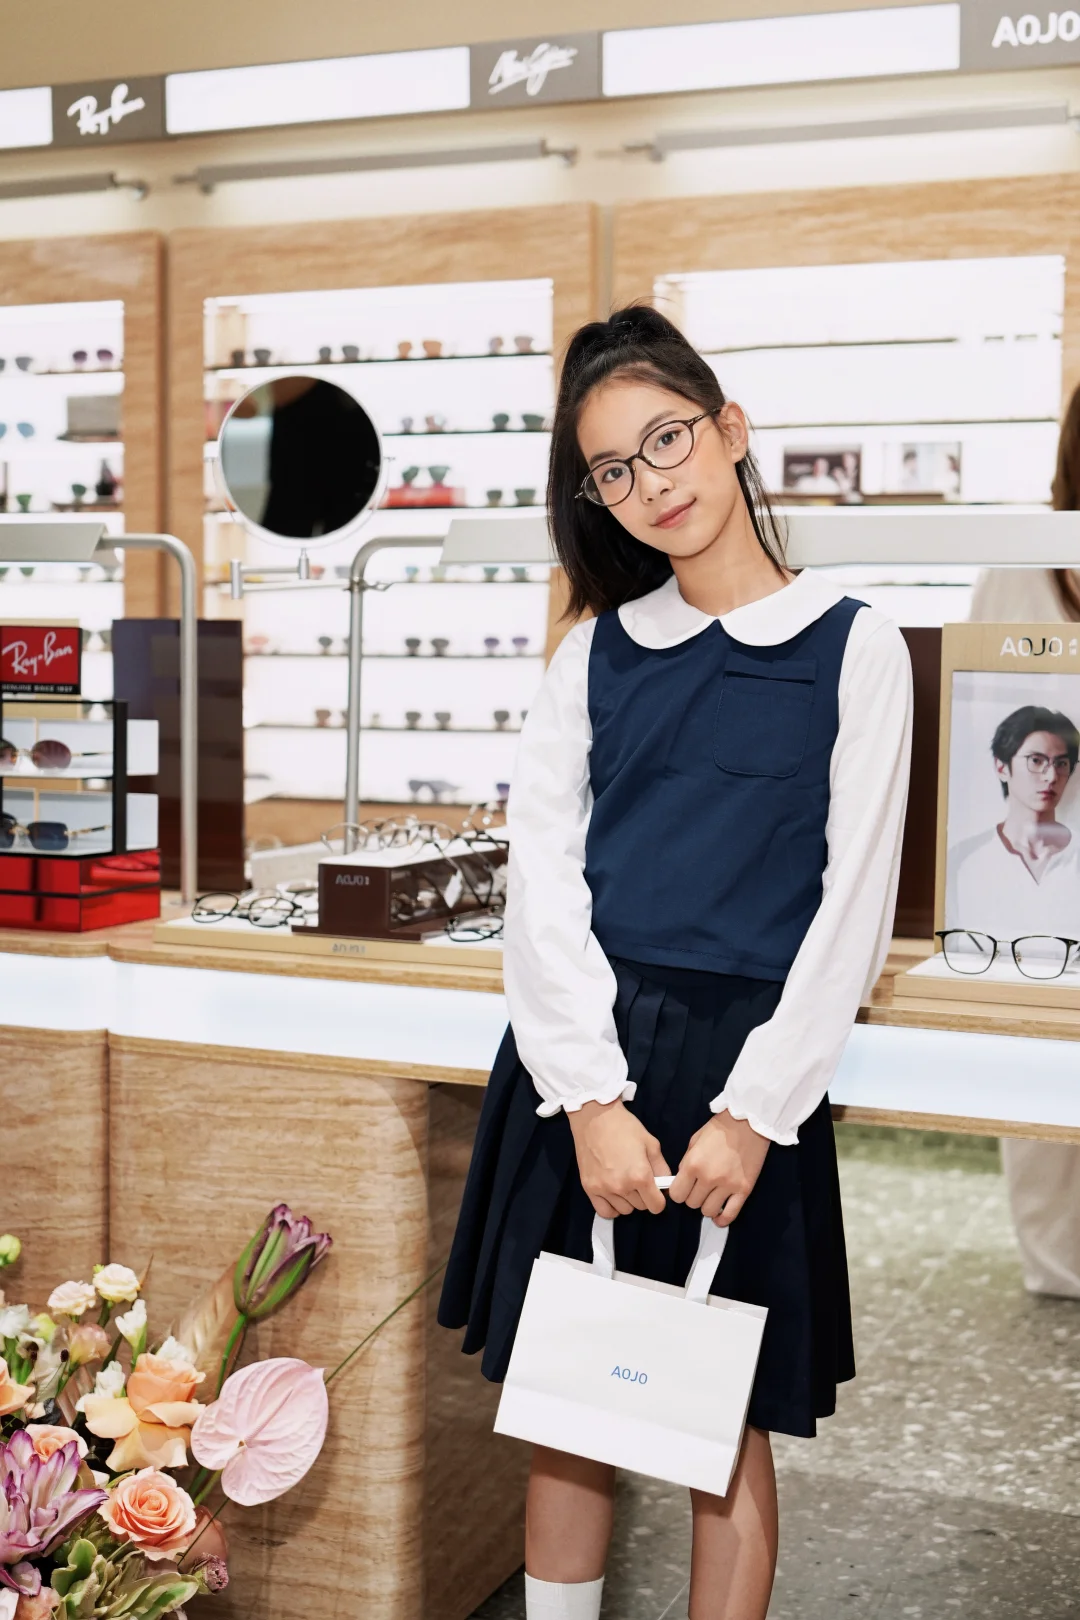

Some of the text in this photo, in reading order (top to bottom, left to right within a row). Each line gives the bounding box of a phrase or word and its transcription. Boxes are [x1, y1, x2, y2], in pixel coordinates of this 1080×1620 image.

[991, 10, 1080, 48] AOJO
[1, 631, 73, 676] Ray-Ban
[999, 635, 1063, 657] AOJO
[610, 1365, 648, 1385] AOJO
